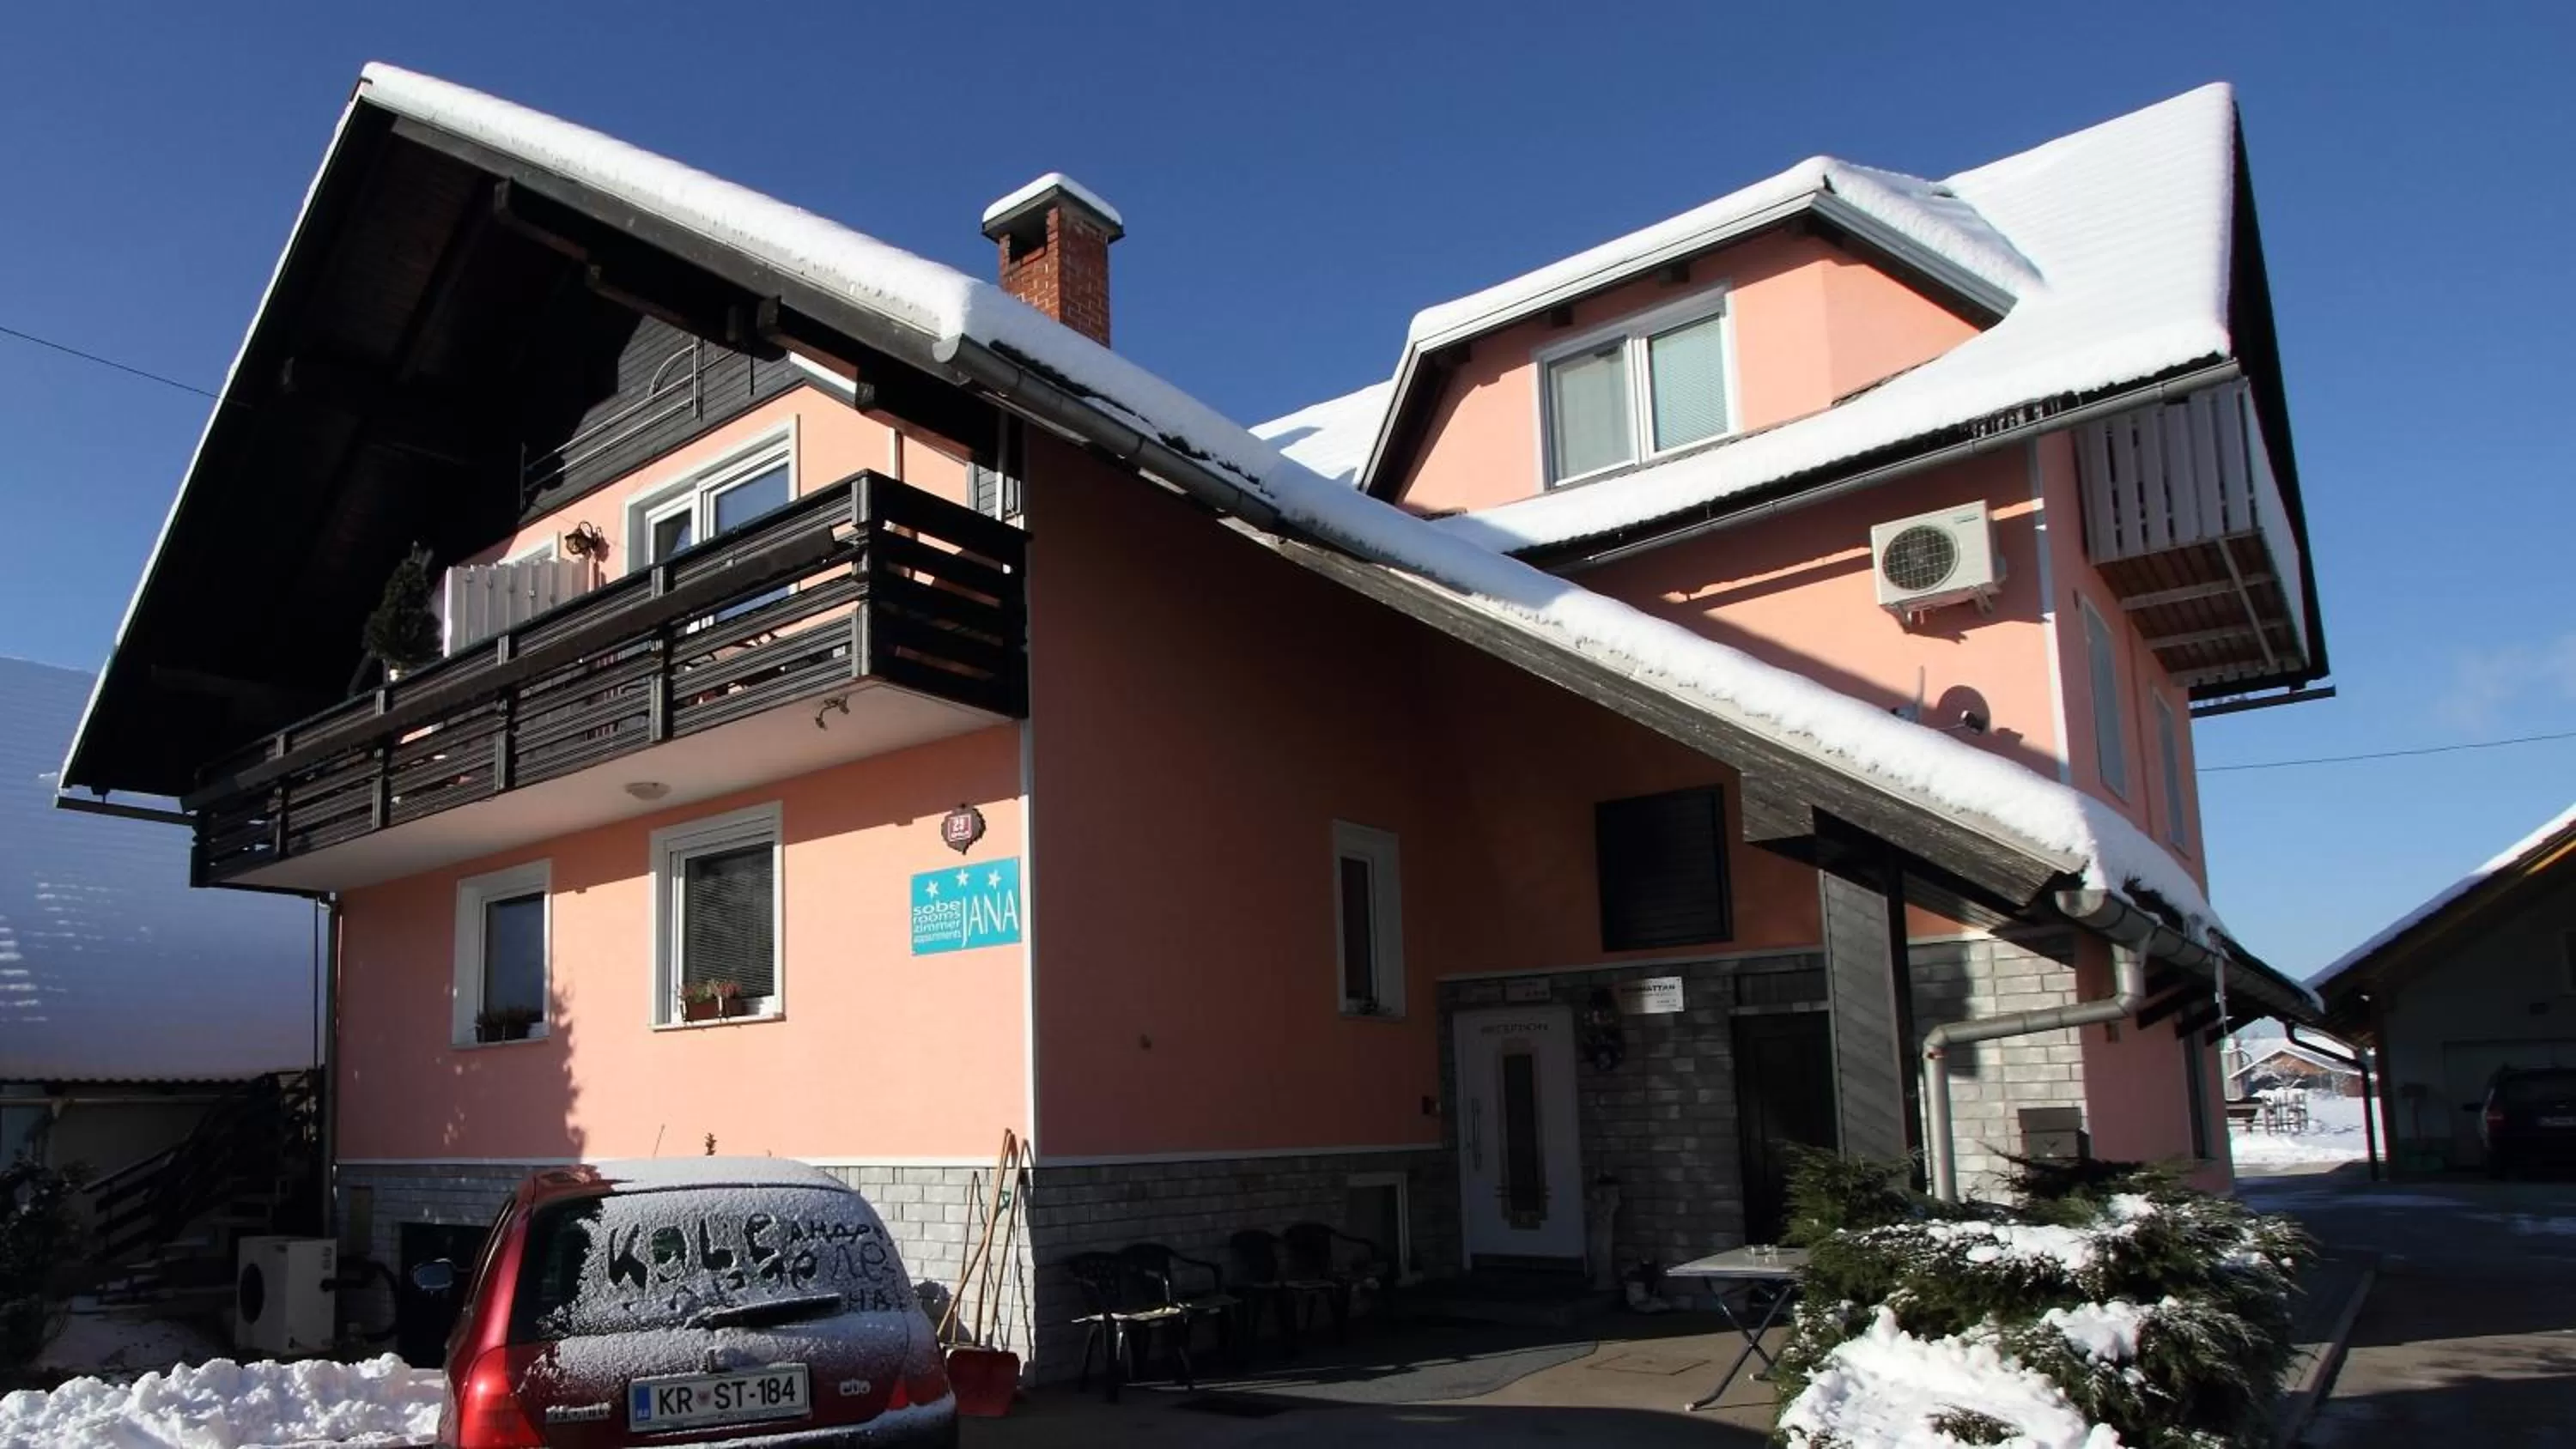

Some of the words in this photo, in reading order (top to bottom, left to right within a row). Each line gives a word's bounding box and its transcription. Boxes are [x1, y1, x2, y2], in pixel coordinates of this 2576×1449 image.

[913, 900, 961, 916] sobe
[913, 911, 961, 925] rooms
[961, 889, 1019, 949] JANA
[913, 920, 960, 933] zimmer
[659, 1386, 694, 1416] KR
[714, 1375, 796, 1410] ST-184
